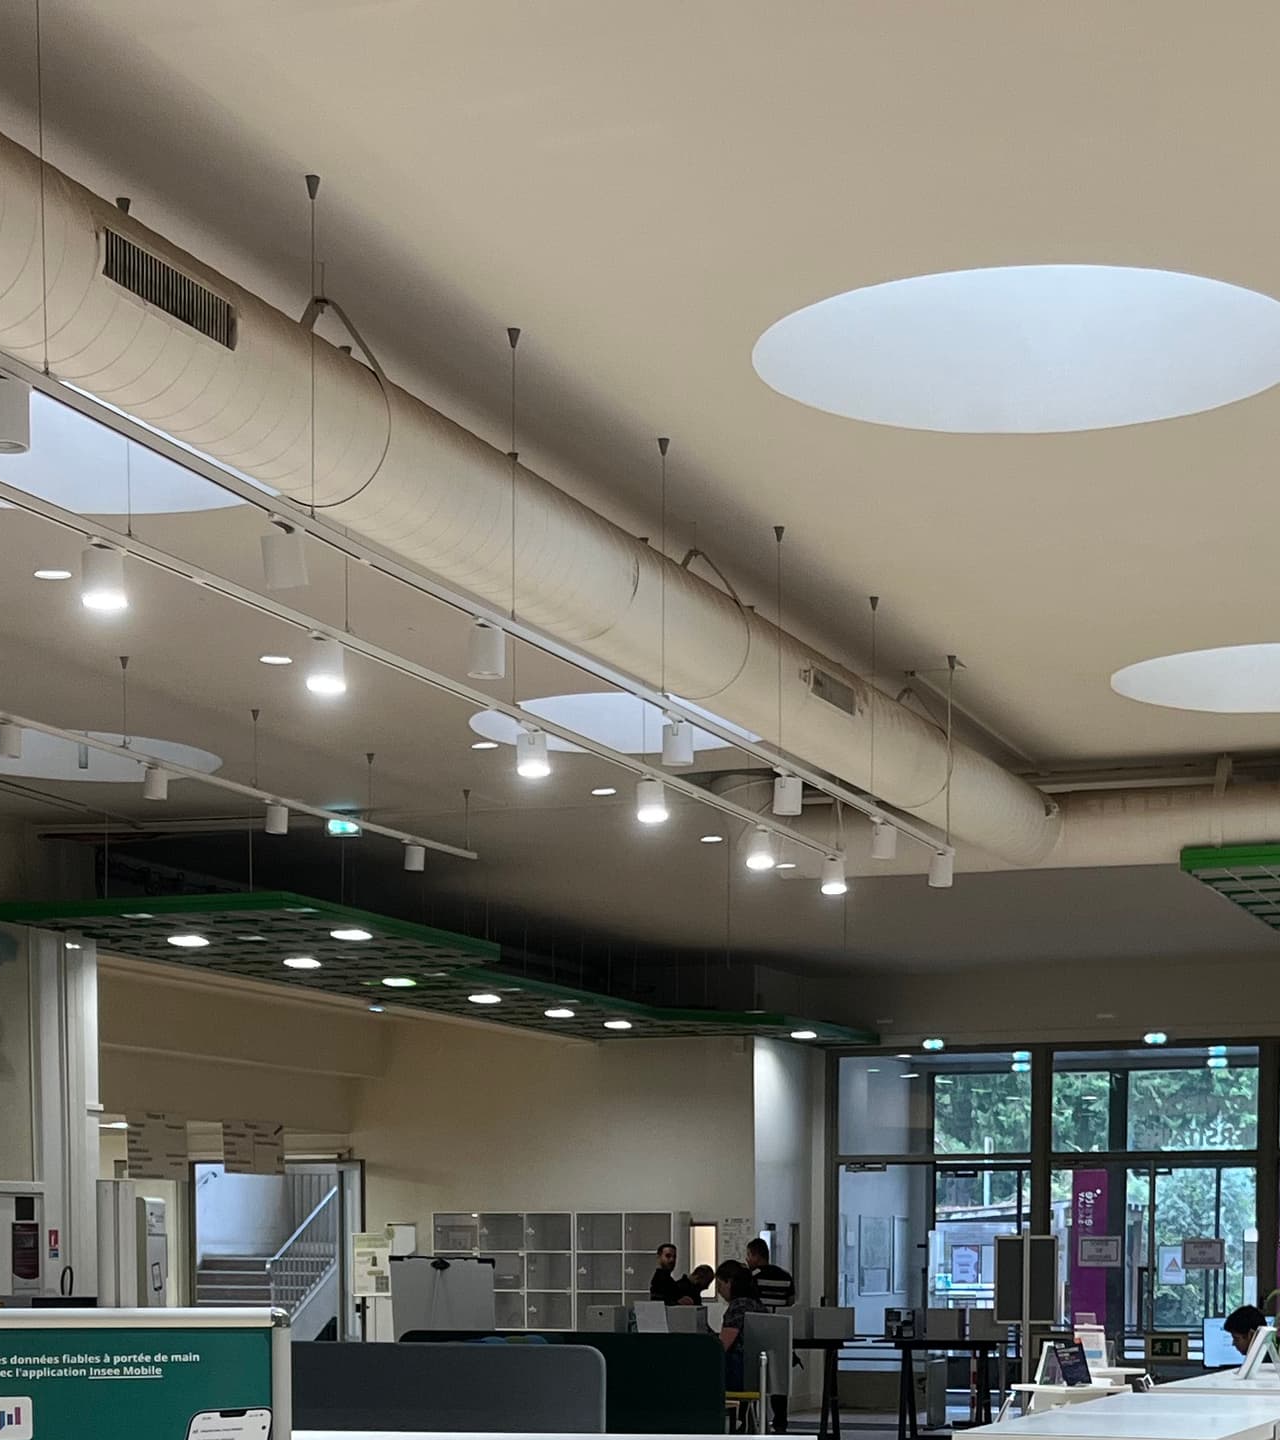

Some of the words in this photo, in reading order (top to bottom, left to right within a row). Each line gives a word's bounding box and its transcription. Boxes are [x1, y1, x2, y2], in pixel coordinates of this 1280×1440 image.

[10, 1354, 60, 1365] données
[62, 1354, 101, 1364] fiables
[103, 1353, 111, 1363] à
[113, 1353, 151, 1365] portée
[153, 1353, 168, 1363] de
[171, 1352, 200, 1362] main
[15, 1367, 87, 1379] l'application
[89, 1367, 120, 1376] Insee
[123, 1366, 162, 1376] Mobile
